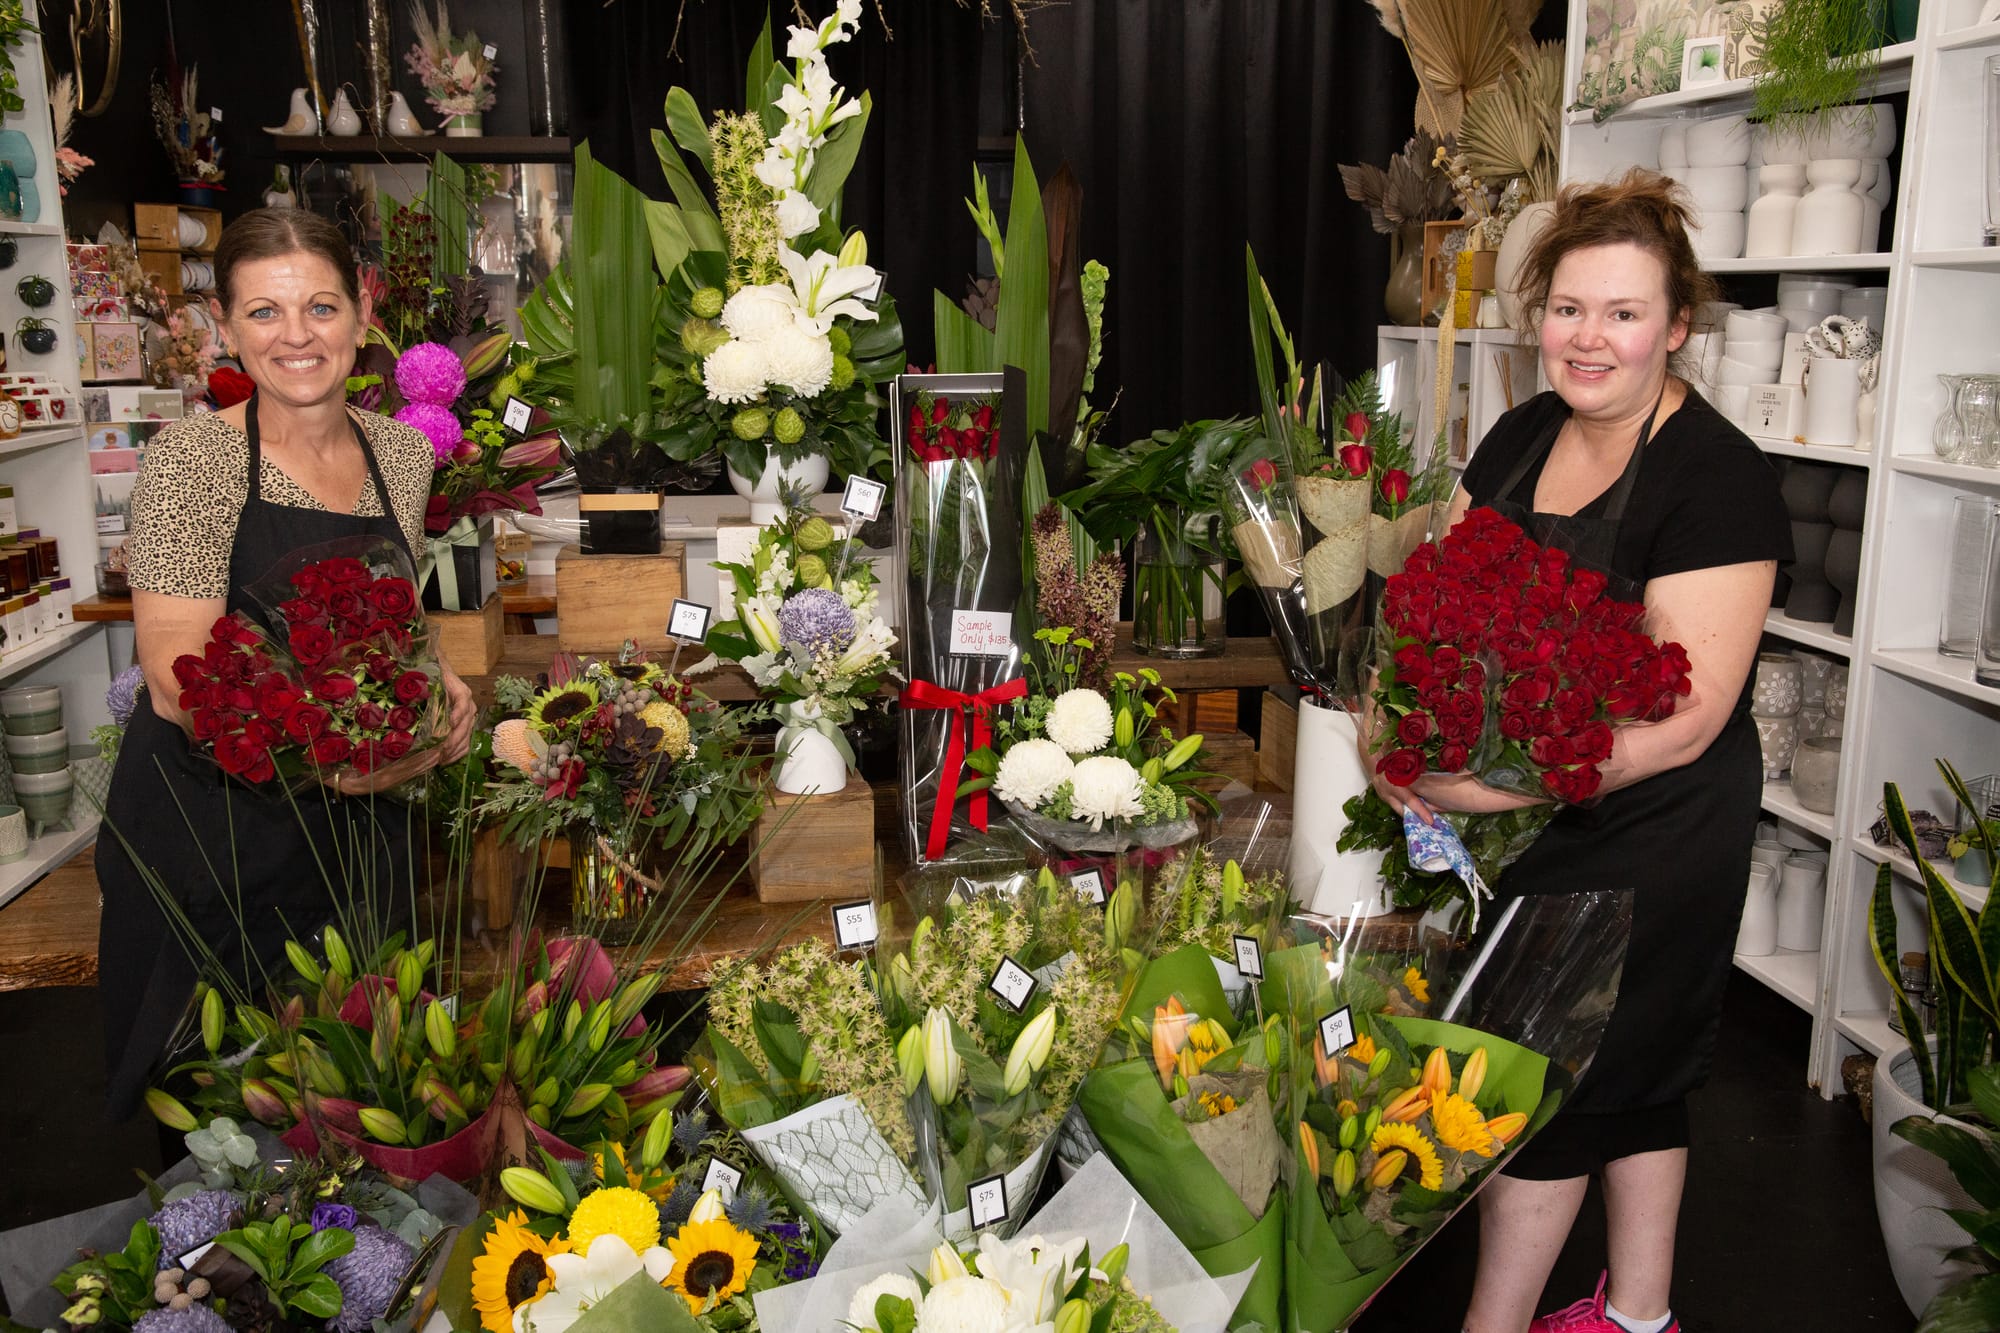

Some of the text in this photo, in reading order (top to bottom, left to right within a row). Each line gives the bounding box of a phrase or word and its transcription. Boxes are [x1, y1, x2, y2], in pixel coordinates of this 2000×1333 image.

[1762, 391, 1776, 400] LIFE
[513, 406, 524, 416] $90
[1762, 409, 1773, 417] CAT
[857, 487, 872, 497] $60
[682, 610, 697, 620] $75
[957, 615, 993, 633] Sample
[960, 632, 1007, 650] Only $135
[1079, 880, 1093, 889] $55
[846, 914, 862, 924] $55
[1242, 946, 1253, 956] $50
[1007, 971, 1023, 986] $55
[1329, 1019, 1342, 1033] $50
[715, 1169, 731, 1184] $68
[979, 1189, 994, 1203] $75
